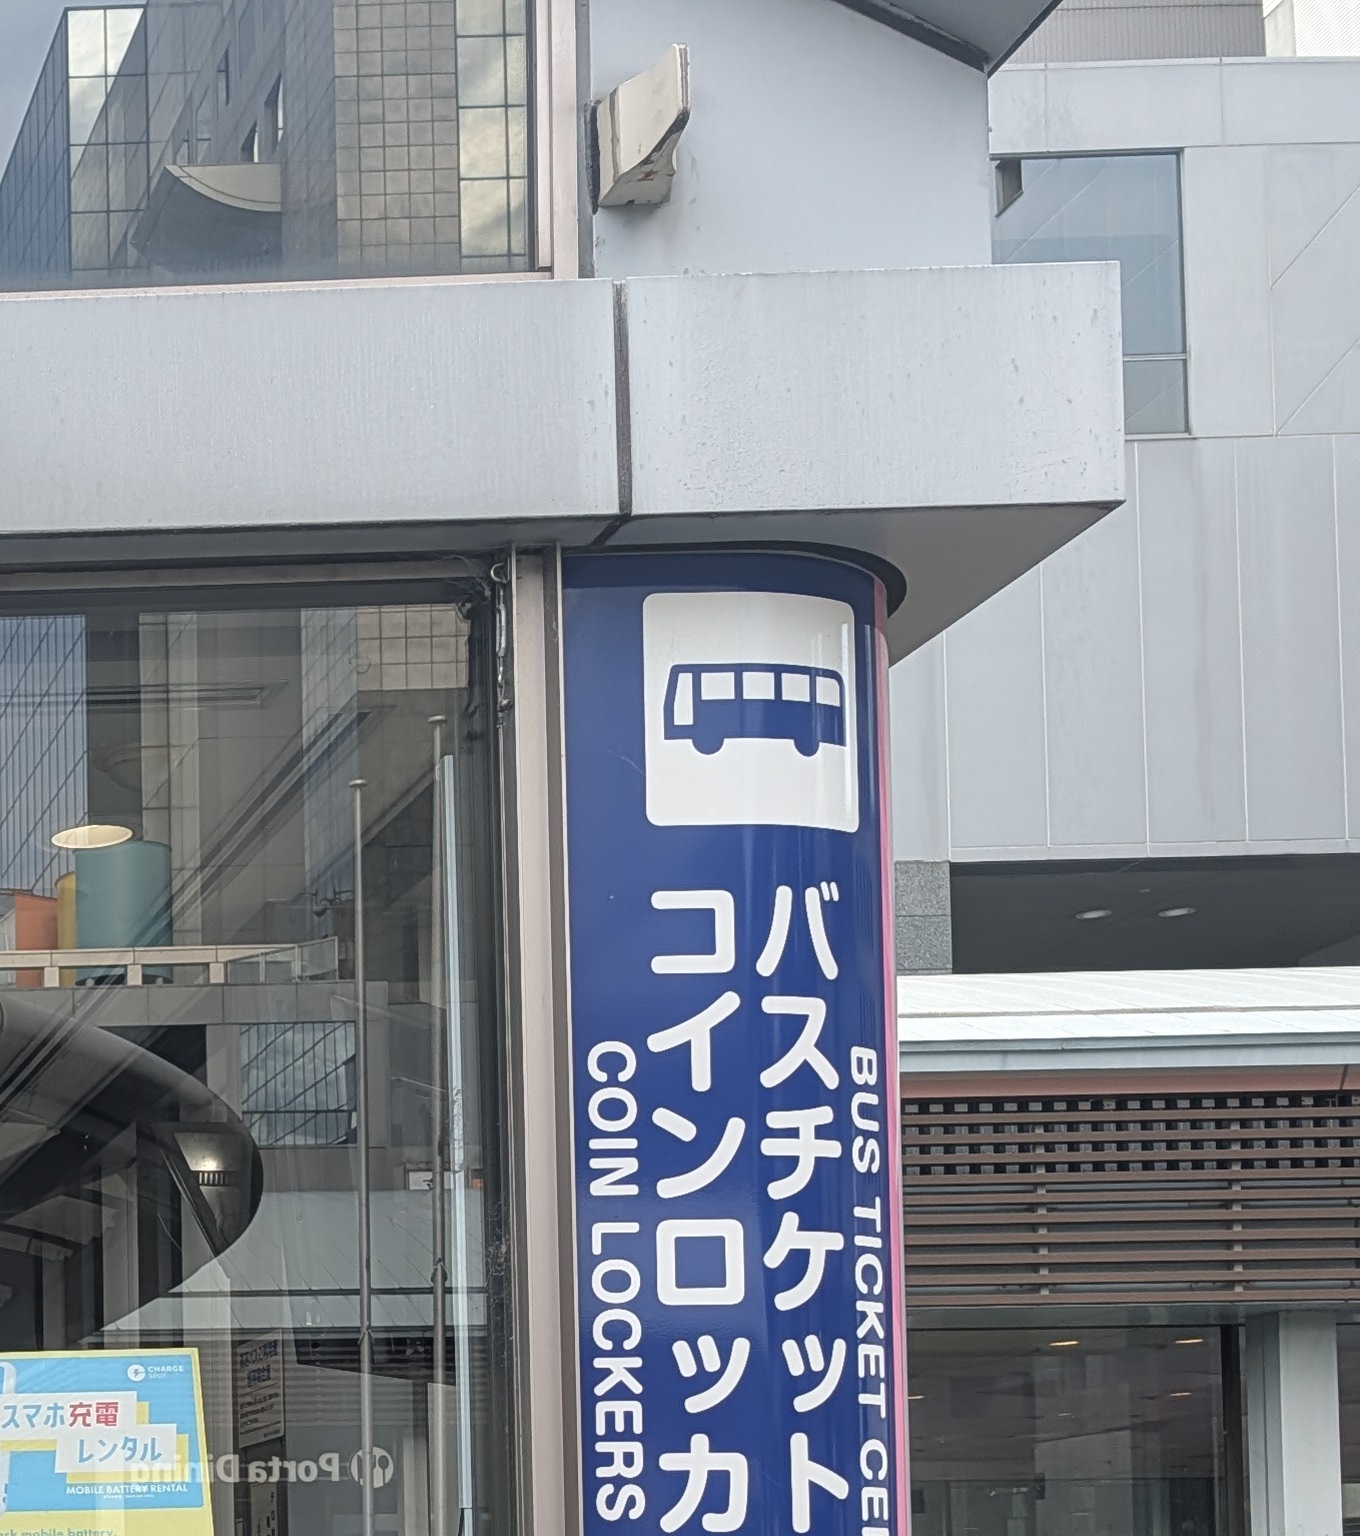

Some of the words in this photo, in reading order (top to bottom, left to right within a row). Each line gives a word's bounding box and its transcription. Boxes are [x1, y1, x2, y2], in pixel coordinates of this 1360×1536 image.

[587, 1040, 639, 1197] COIN
[849, 1045, 879, 1175] BUS
[852, 1198, 887, 1420] TICKET
[147, 1364, 185, 1374] CHARGE
[589, 1220, 647, 1523] LOCKERS
[1, 1400, 120, 1431] スマホ充電
[78, 1436, 163, 1465] レンタル
[66, 1485, 104, 1496] MOBILE
[105, 1484, 148, 1495] BATTERY
[149, 1482, 189, 1494] RENTAL
